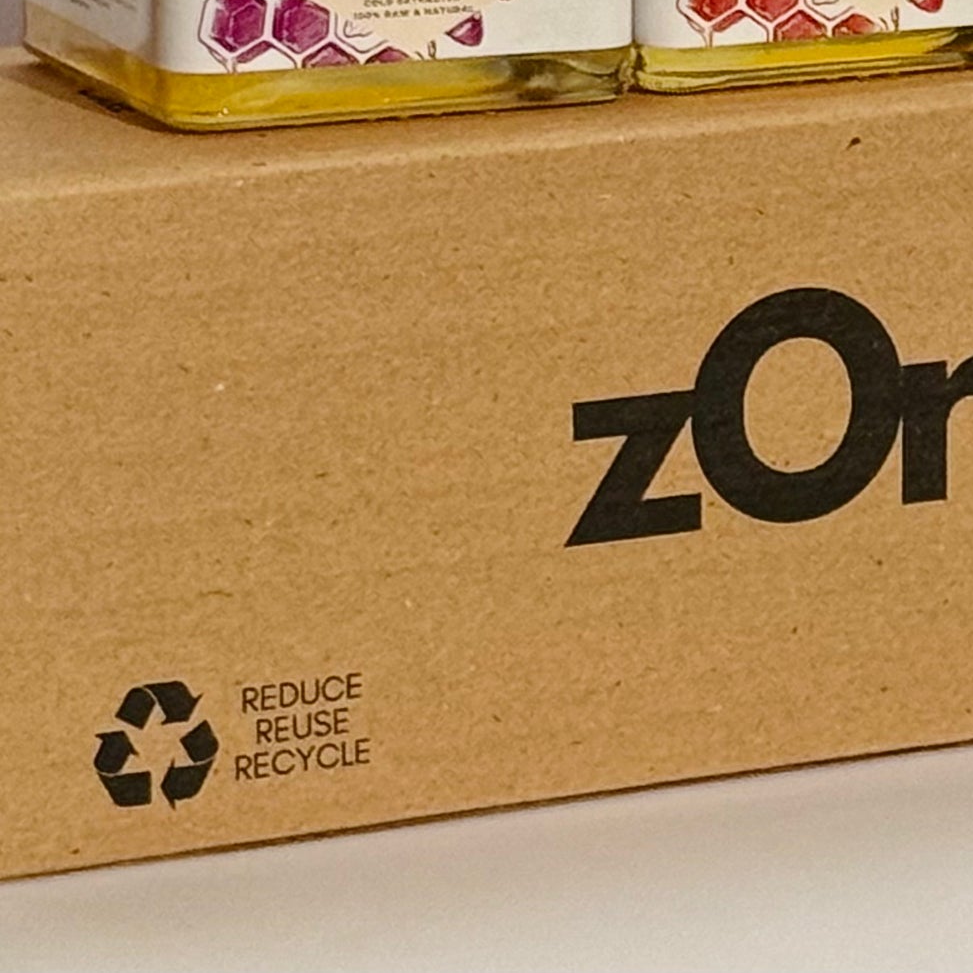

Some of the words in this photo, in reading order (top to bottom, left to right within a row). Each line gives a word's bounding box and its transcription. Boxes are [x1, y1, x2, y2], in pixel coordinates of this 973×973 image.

[241, 672, 363, 714] REDUCE
[256, 707, 350, 744] REUSE
[234, 737, 371, 781] RECYCLE
